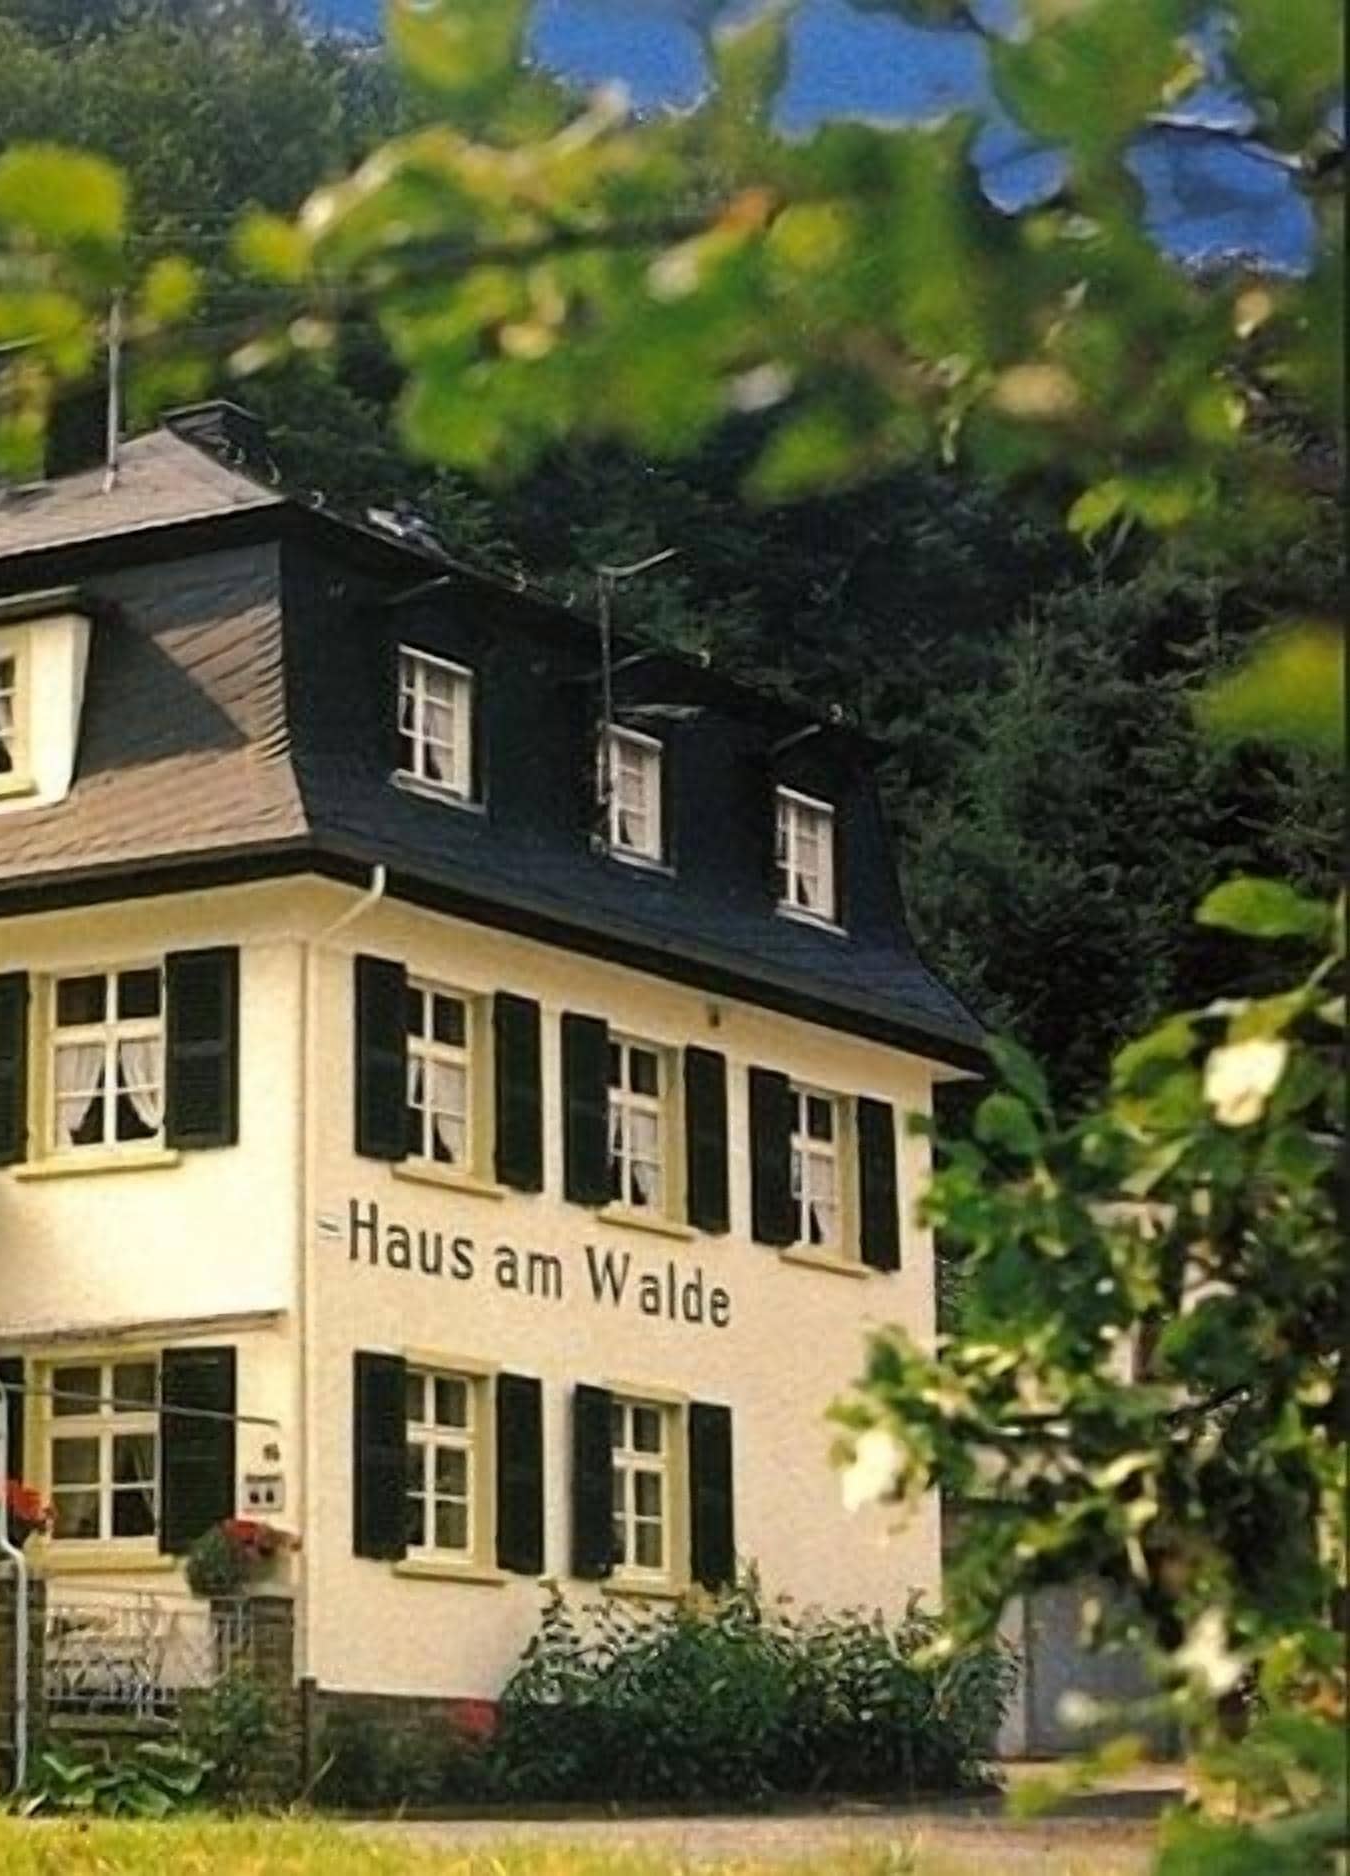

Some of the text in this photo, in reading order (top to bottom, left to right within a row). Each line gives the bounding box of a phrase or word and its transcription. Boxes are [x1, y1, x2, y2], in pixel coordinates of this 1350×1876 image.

[349, 1197, 731, 1328] Haus am Walde
